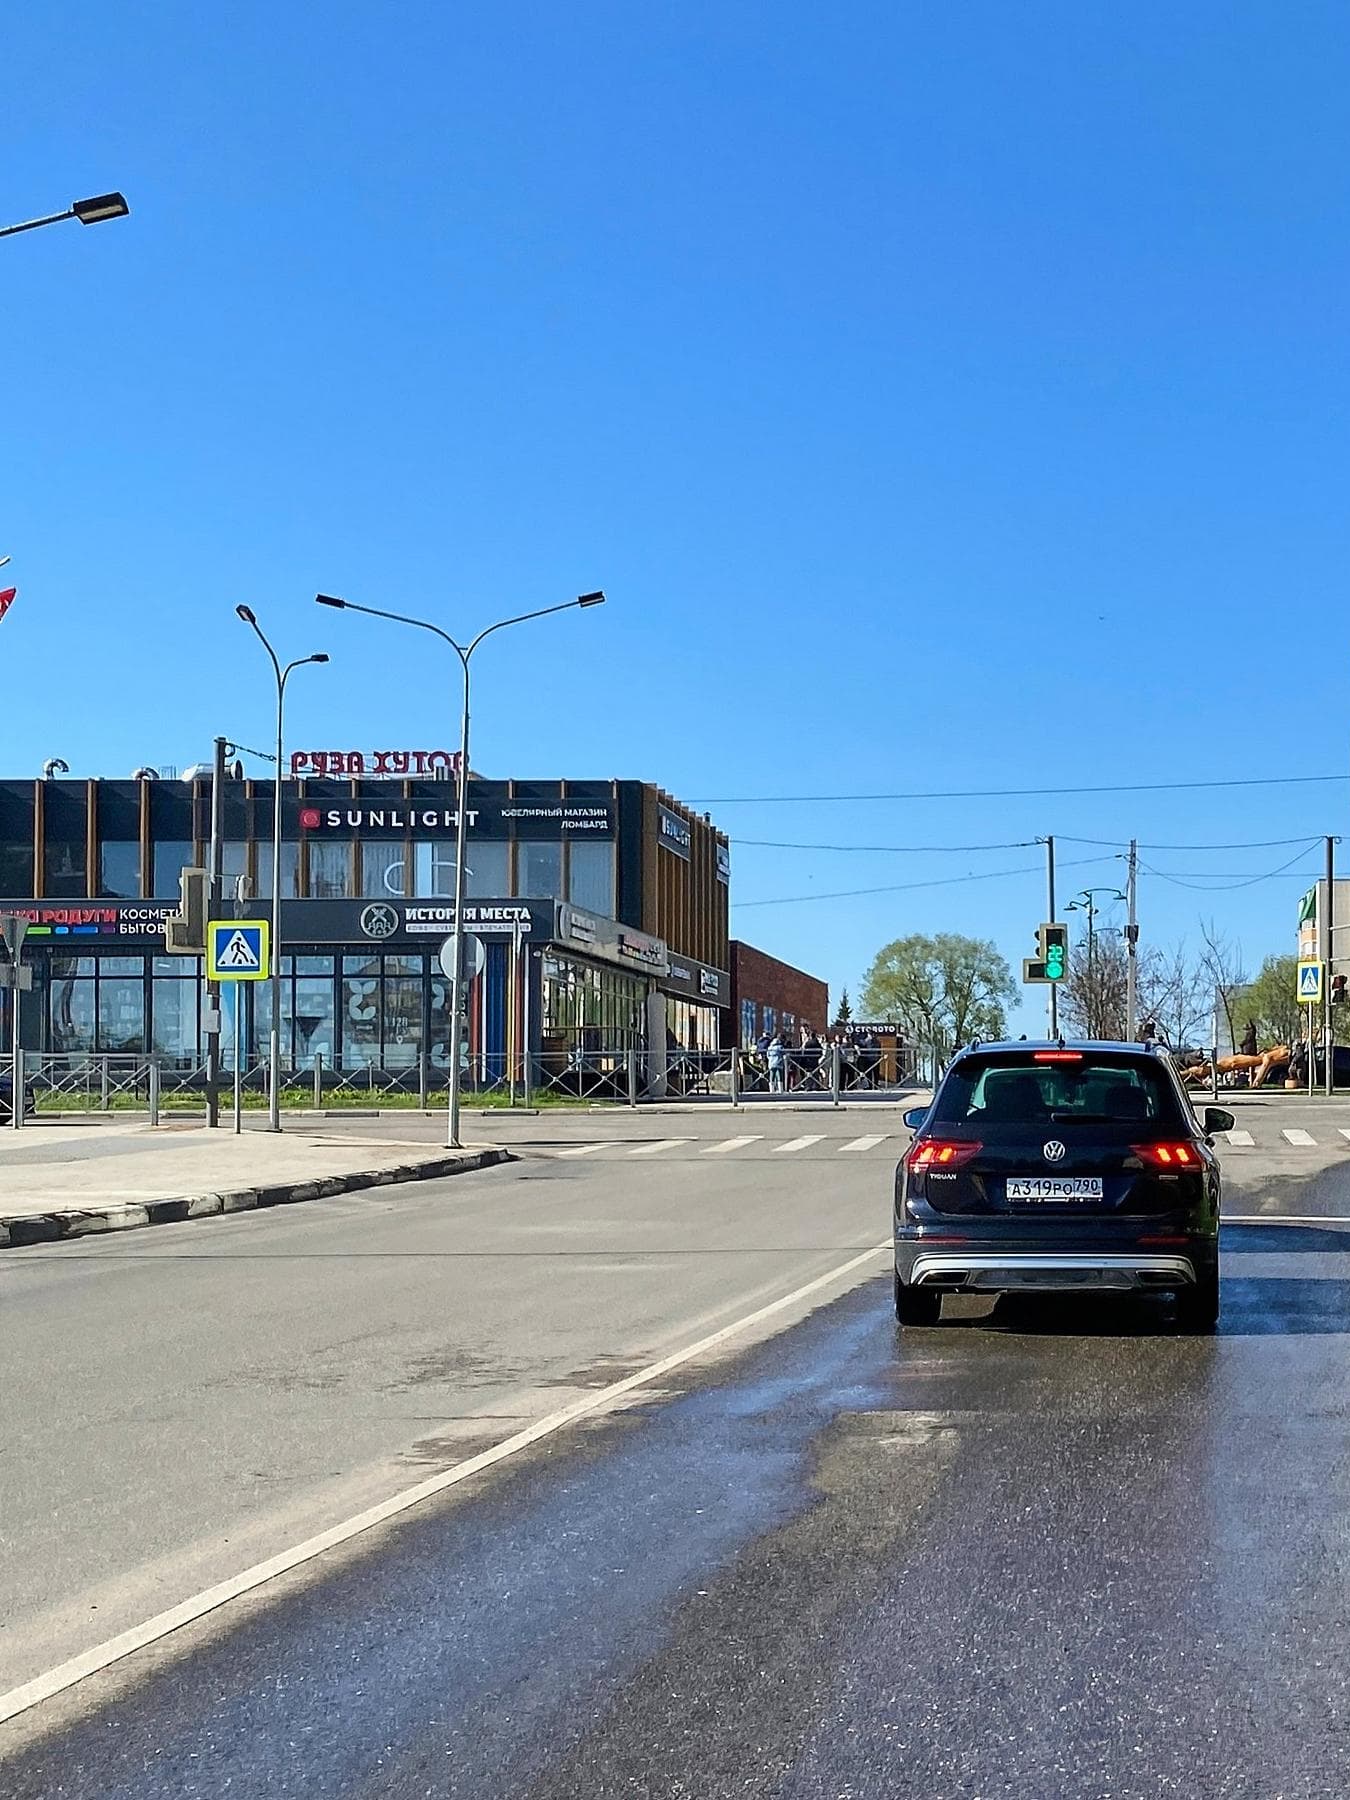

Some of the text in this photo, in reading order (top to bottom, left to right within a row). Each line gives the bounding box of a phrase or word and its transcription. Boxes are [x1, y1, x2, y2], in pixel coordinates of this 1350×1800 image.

[501, 808, 608, 817] ЮВЕЛИРНЫЙ МАГАЗИН
[327, 810, 480, 828] SUNLIGHT
[561, 820, 609, 830] ЛОМБАРД
[405, 907, 532, 921] ИСТОРЯ МЕСТА
